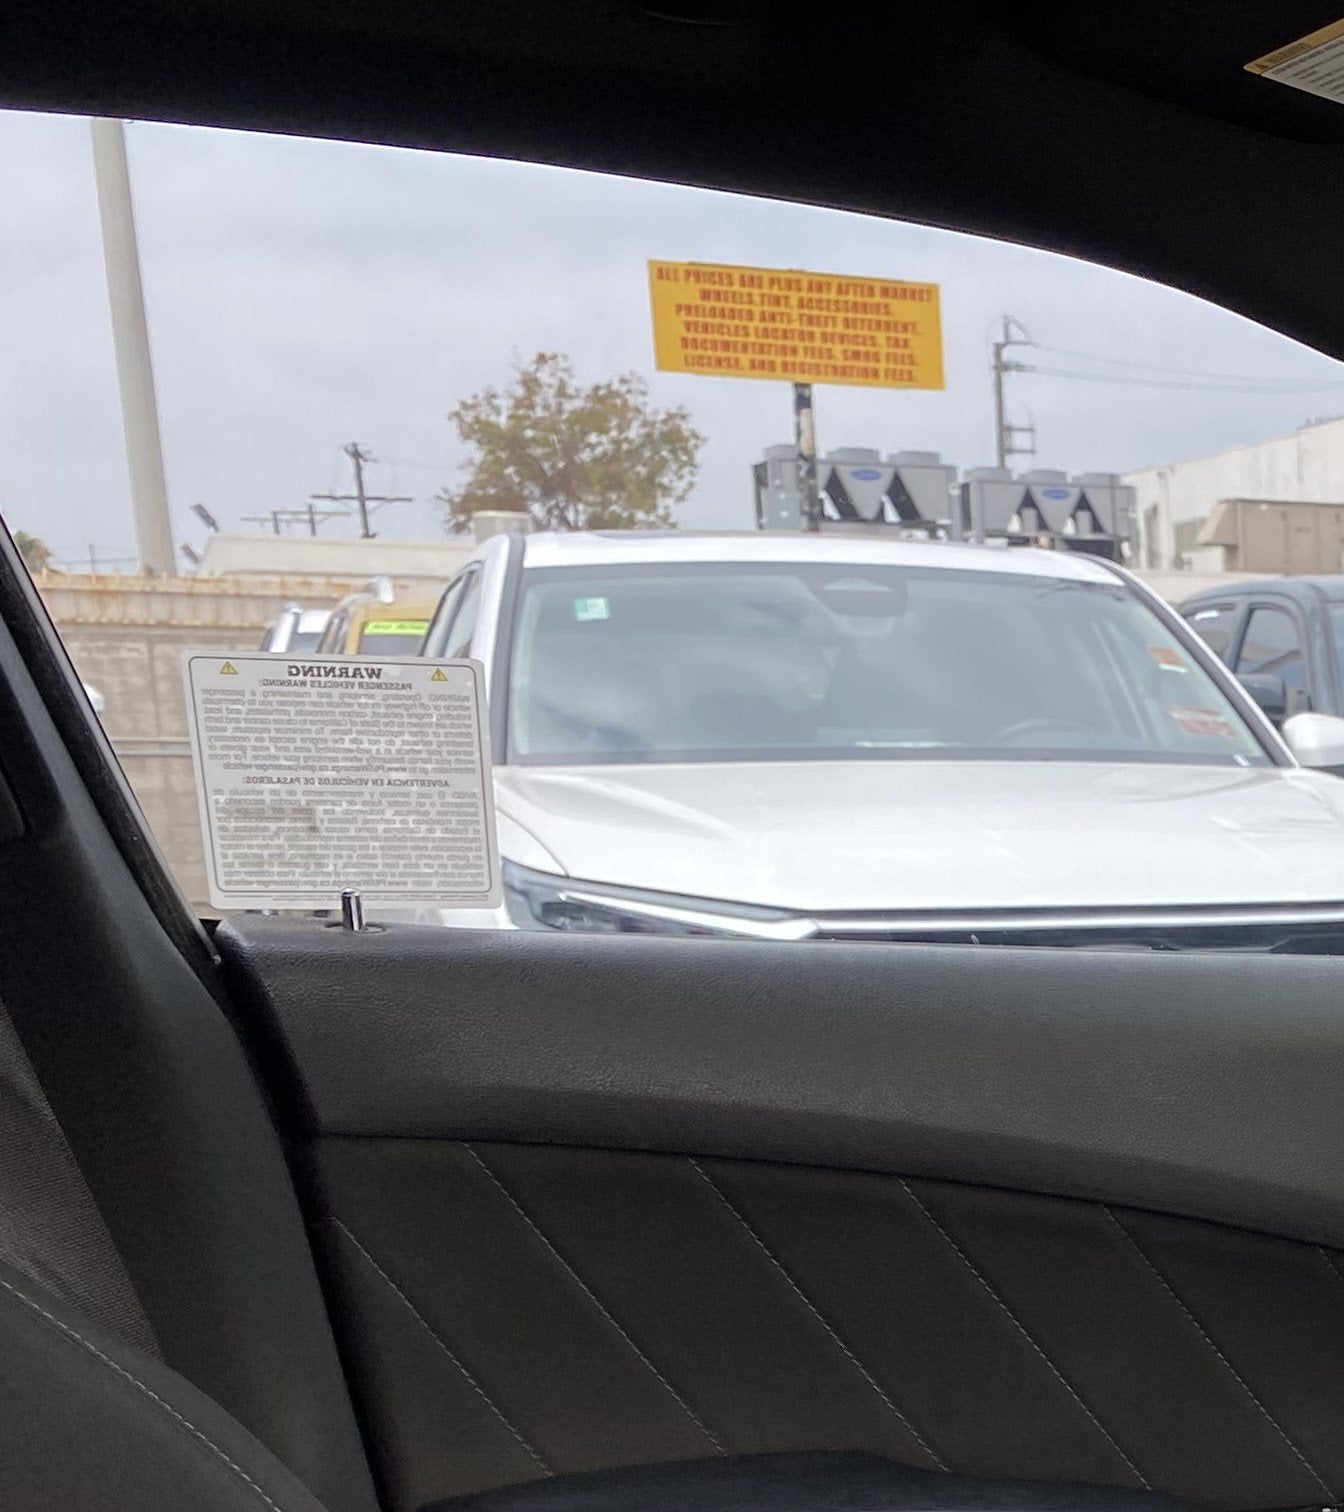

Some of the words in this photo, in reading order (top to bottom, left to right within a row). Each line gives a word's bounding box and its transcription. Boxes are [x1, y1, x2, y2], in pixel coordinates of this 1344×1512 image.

[656, 267, 680, 282] ALL
[684, 269, 734, 287] PRICES
[739, 274, 764, 290] ARE
[768, 277, 802, 293] PLUS
[807, 280, 832, 295] ANY
[836, 283, 876, 298] AFTER
[880, 286, 933, 301] MARKET
[683, 320, 750, 338] VEHICLES
[754, 326, 815, 343] LOCATOR
[681, 337, 798, 357] DOCUMENTATION
[750, 359, 776, 373] AND
[781, 361, 879, 380] REGISTRATION
